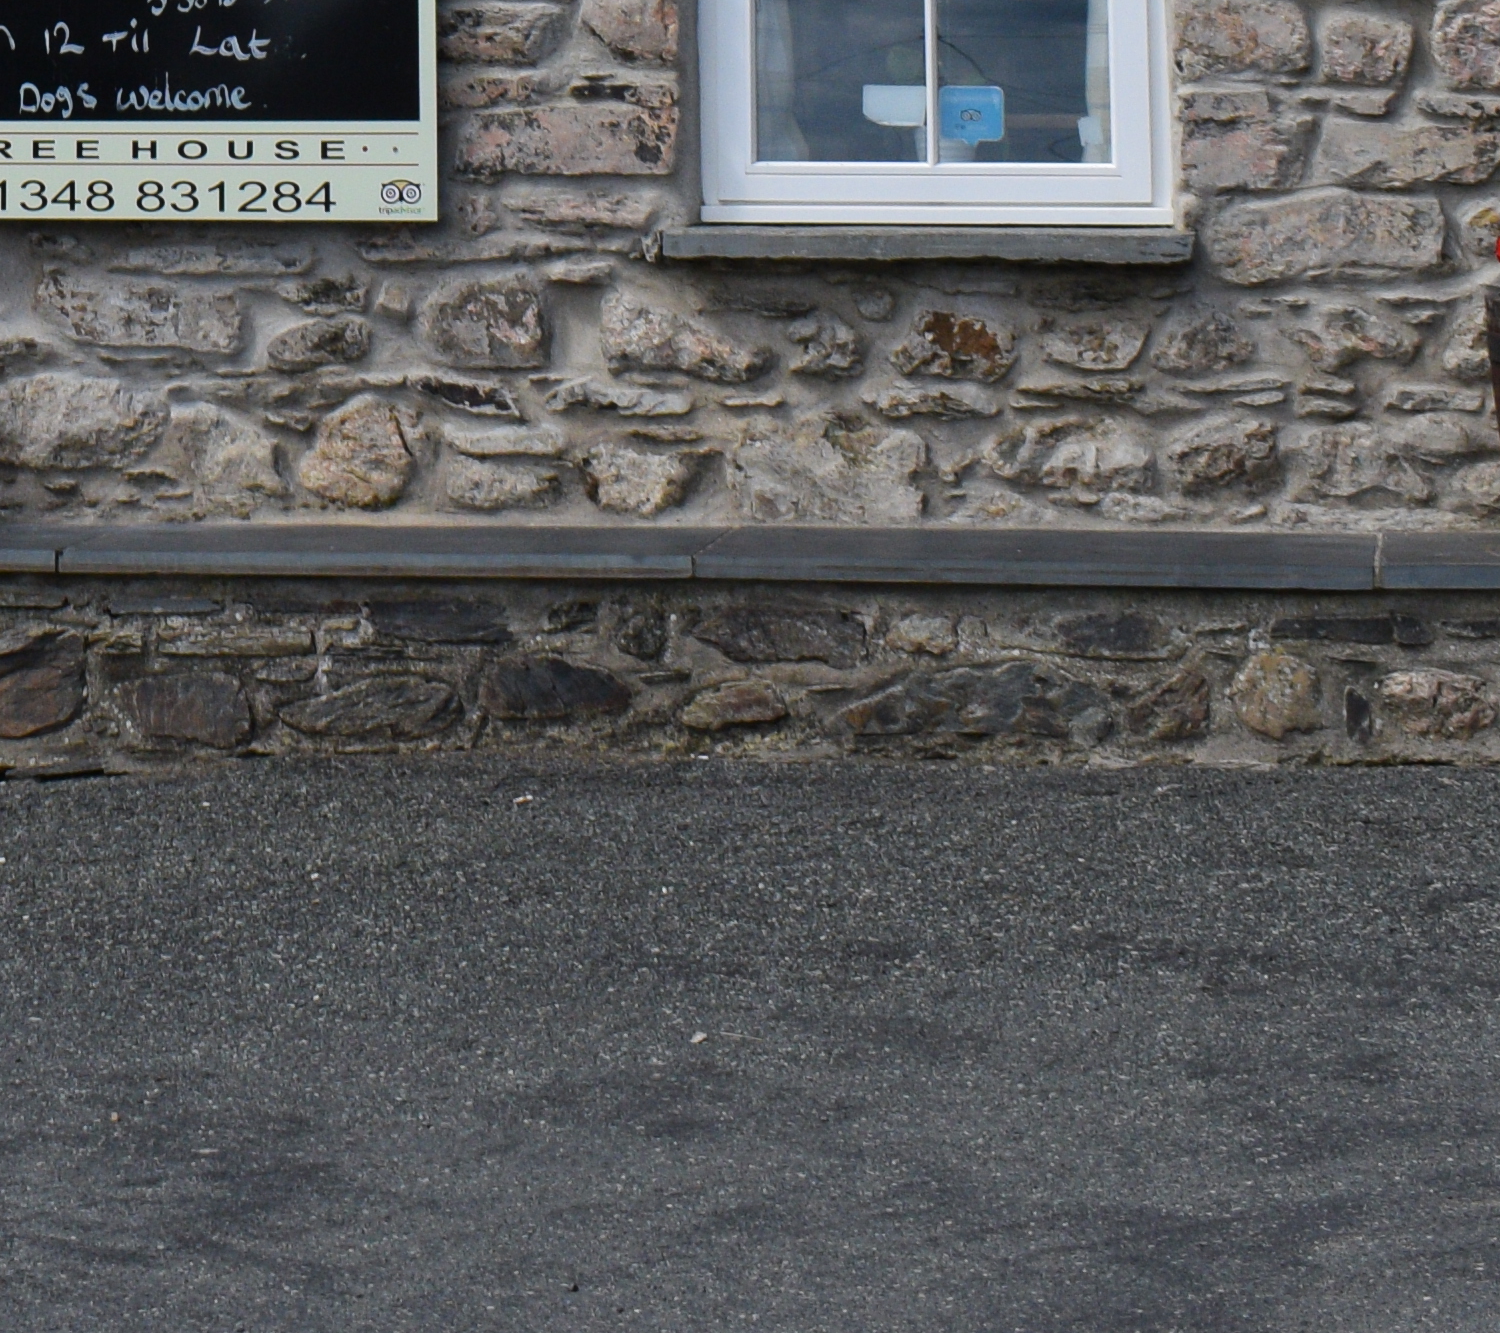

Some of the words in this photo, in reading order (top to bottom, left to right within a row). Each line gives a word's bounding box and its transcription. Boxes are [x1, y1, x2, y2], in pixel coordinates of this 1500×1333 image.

[44, 21, 85, 55] 12
[19, 82, 98, 118] Dogs
[131, 139, 349, 161] HOUSE
[135, 180, 338, 213] 831284
